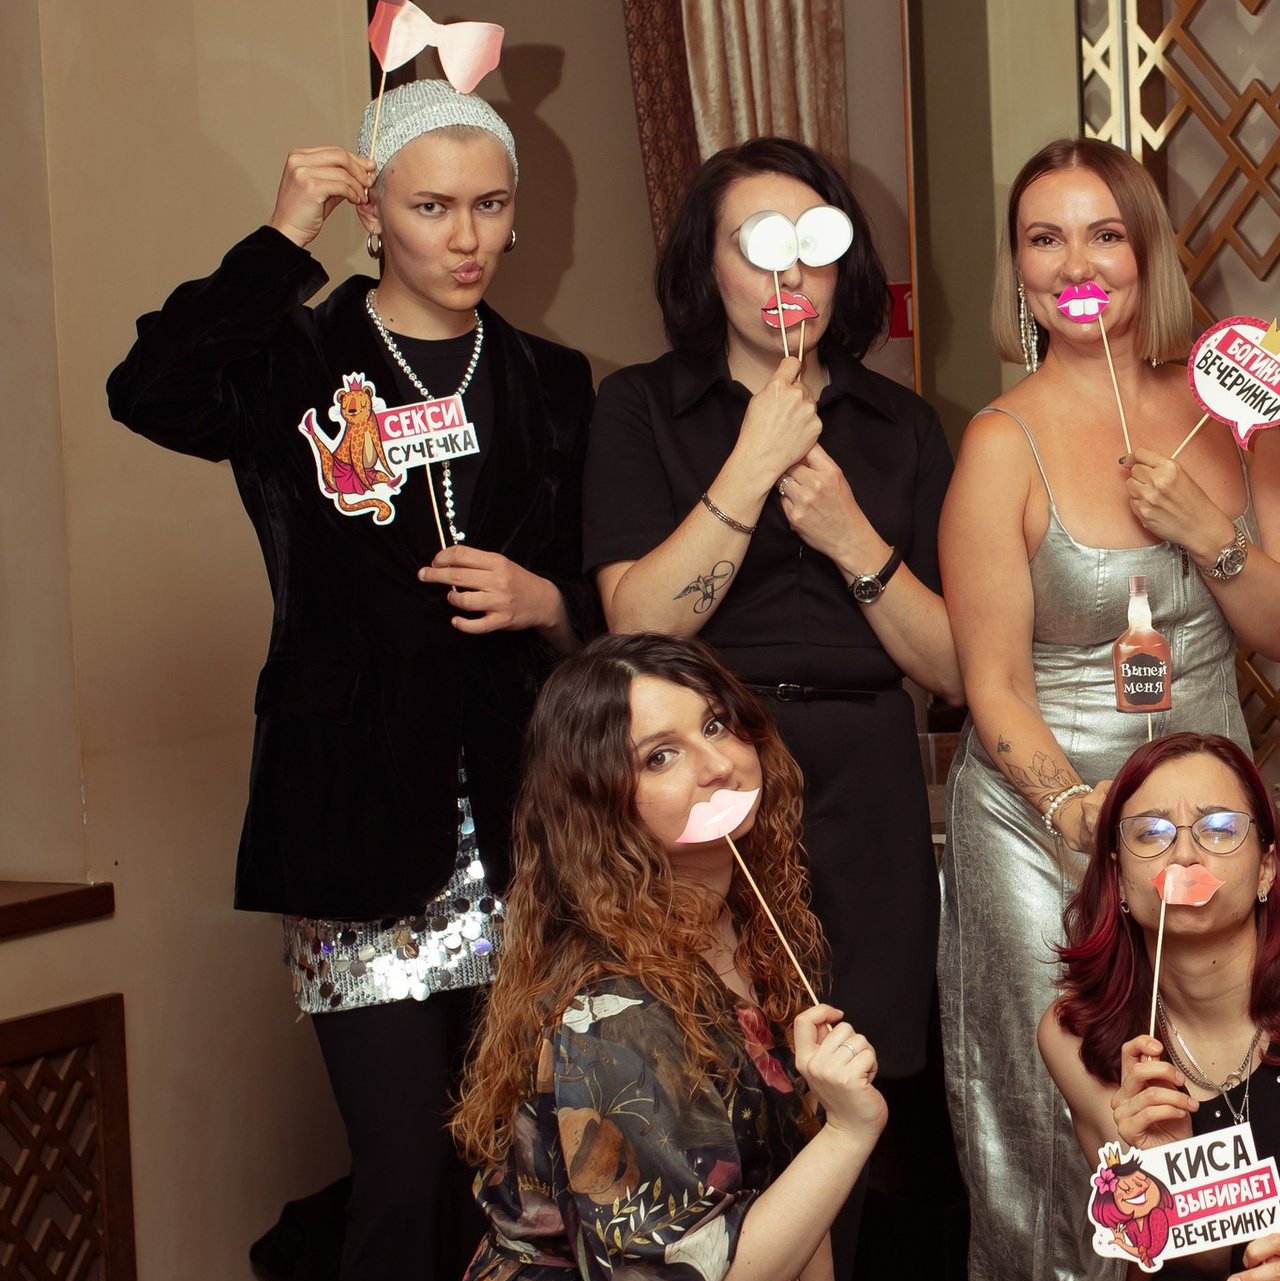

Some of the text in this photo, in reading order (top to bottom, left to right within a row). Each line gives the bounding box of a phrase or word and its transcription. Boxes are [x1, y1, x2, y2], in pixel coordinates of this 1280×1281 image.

[384, 402, 460, 438] СЕКСИ
[388, 430, 475, 465] СУЧЕЧКА
[1120, 661, 1167, 677] Выпей
[1123, 681, 1164, 695] меня
[1164, 1134, 1252, 1186] КИСА
[1174, 1172, 1273, 1218] ВЫБИРАЕТ
[1171, 1205, 1276, 1249] ВЕЧЕРИНКУ
